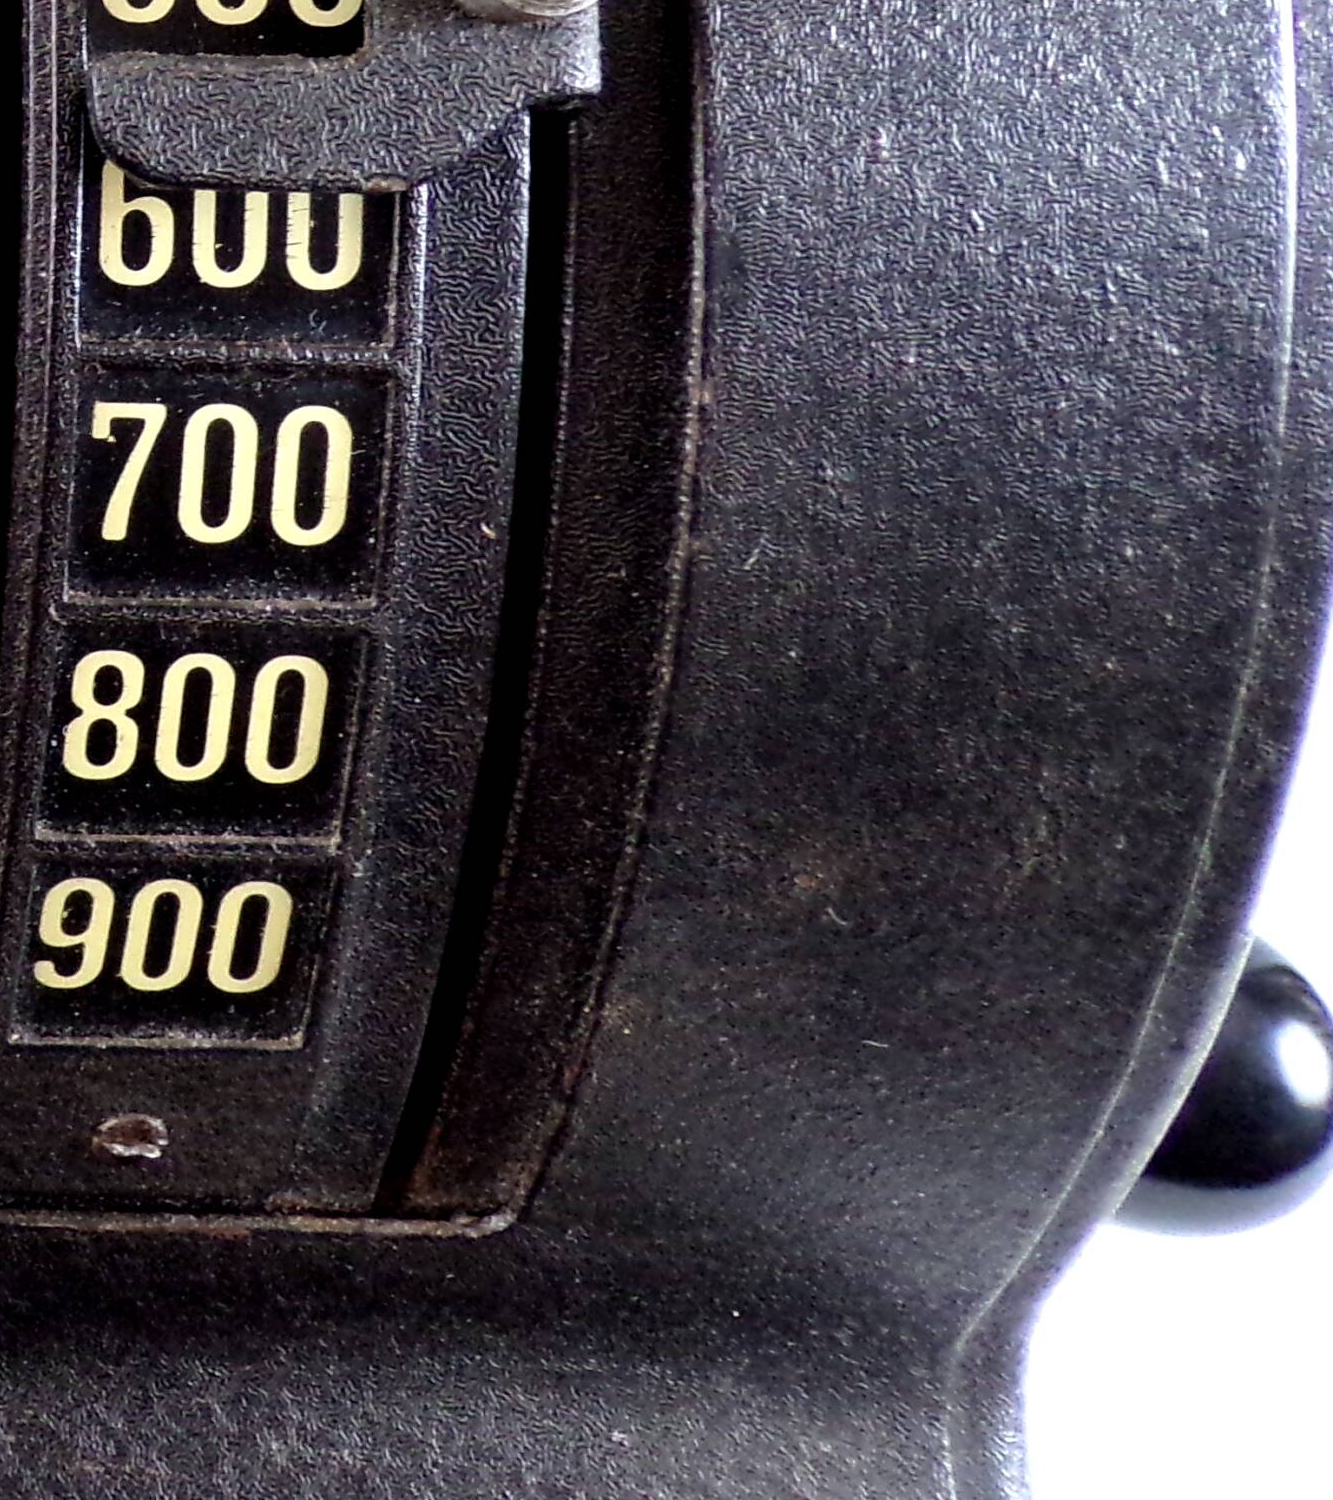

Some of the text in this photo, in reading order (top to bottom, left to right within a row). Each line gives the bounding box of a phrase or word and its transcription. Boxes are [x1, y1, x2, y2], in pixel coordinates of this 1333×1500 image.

[91, 401, 354, 547] 700
[62, 649, 329, 784] 800
[33, 877, 294, 994] 900
